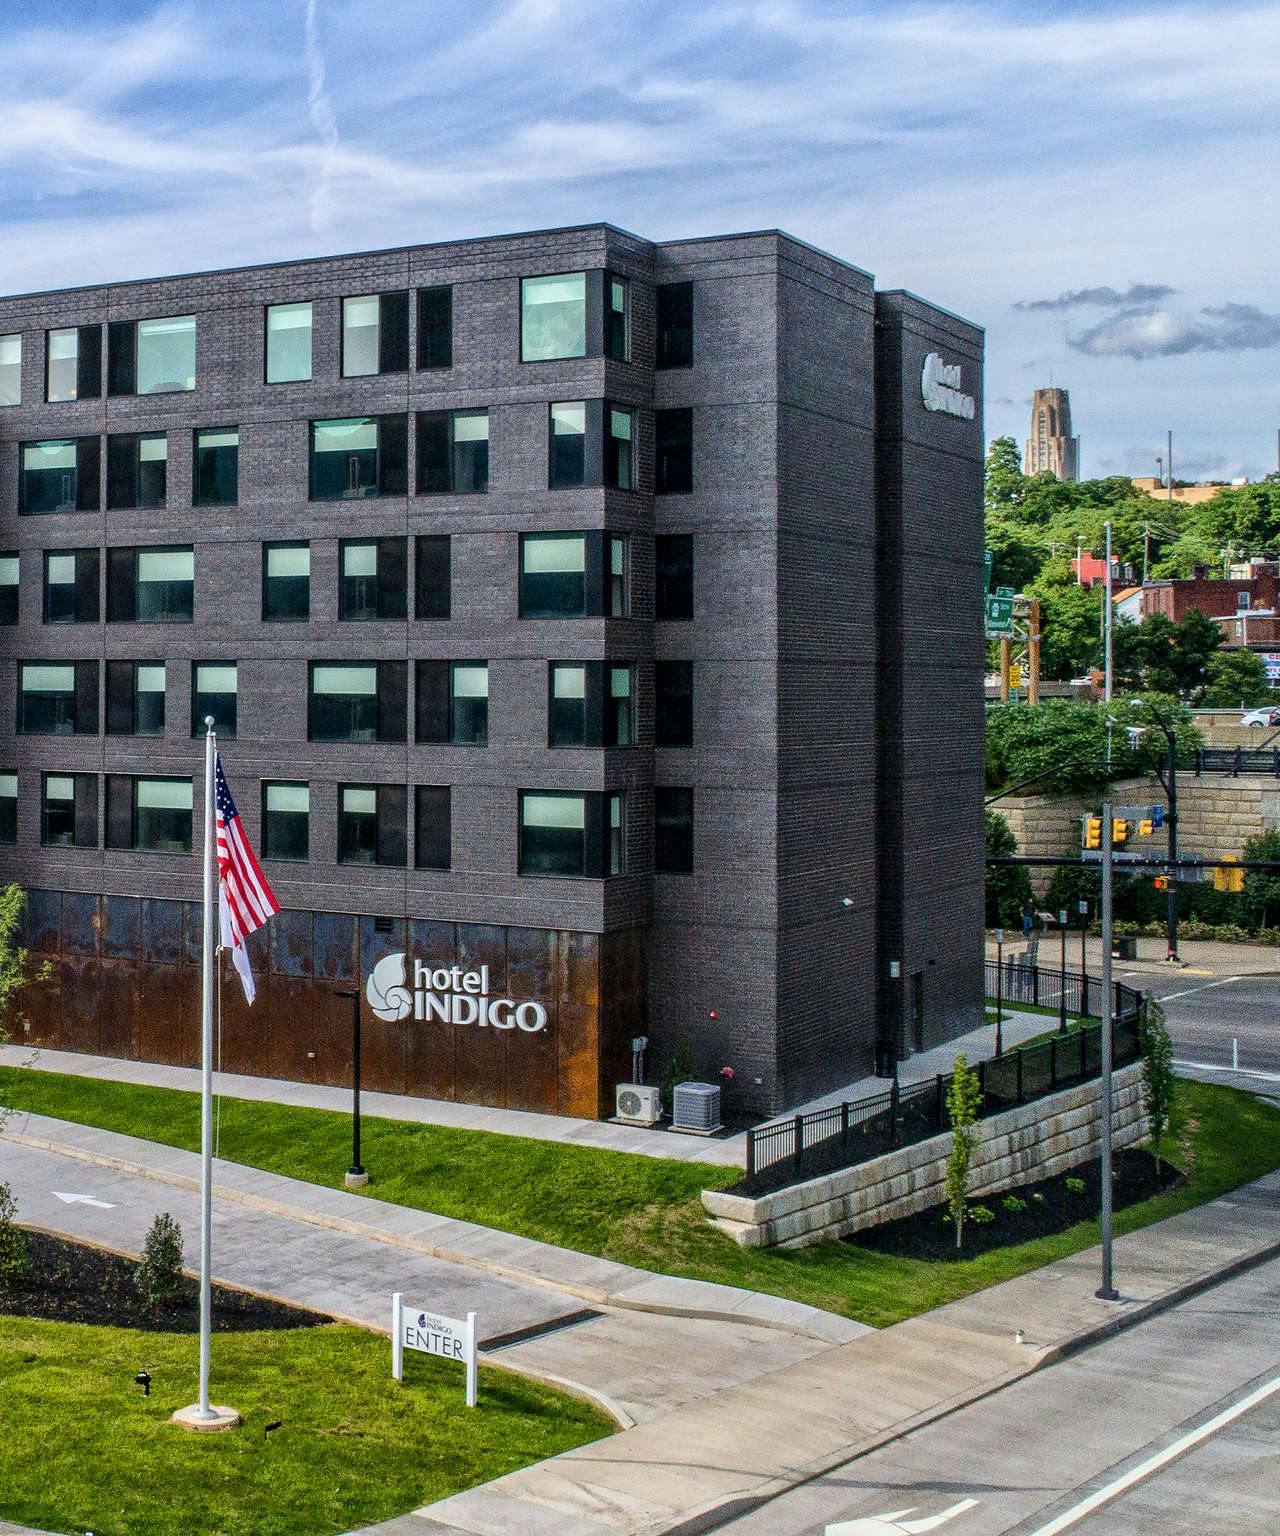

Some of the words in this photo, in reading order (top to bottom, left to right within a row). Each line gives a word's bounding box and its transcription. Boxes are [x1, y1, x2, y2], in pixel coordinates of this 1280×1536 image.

[414, 959, 489, 995] hotel
[414, 991, 547, 1032] INDIGO
[406, 1326, 463, 1359] ENTER
